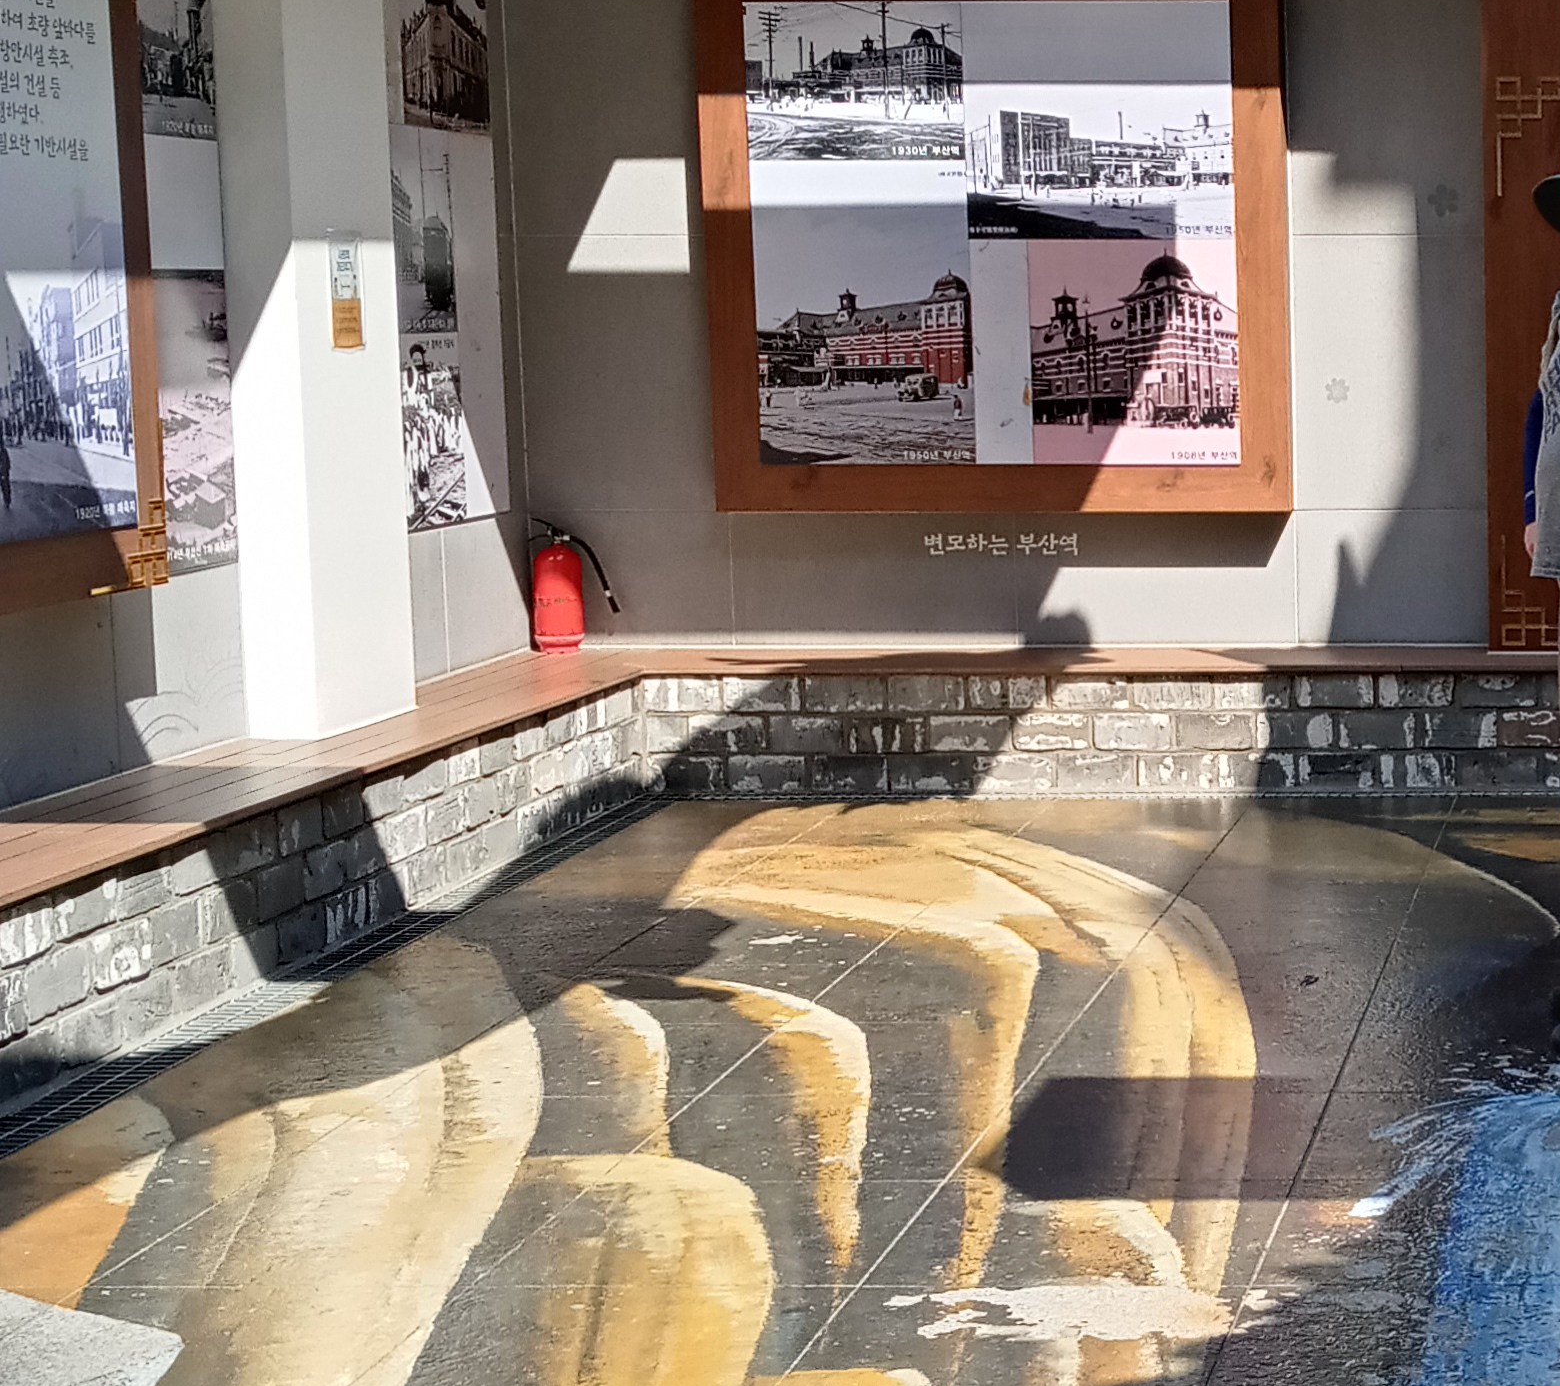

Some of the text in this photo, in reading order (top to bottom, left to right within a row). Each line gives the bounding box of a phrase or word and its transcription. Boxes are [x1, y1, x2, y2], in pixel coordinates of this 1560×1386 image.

[27, 12, 50, 37] 초량
[52, 17, 96, 45] 앞바다를
[23, 73, 48, 98] 건설
[50, 77, 61, 99] 등
[34, 135, 89, 162] 기반시설을
[892, 145, 960, 156] 1930년 부산역
[1205, 225, 1233, 236] 부산역
[903, 450, 971, 461] 1950년 부산역
[1171, 450, 1238, 461] 1908년 부산역
[924, 533, 1078, 556] 변모하는 부산역
